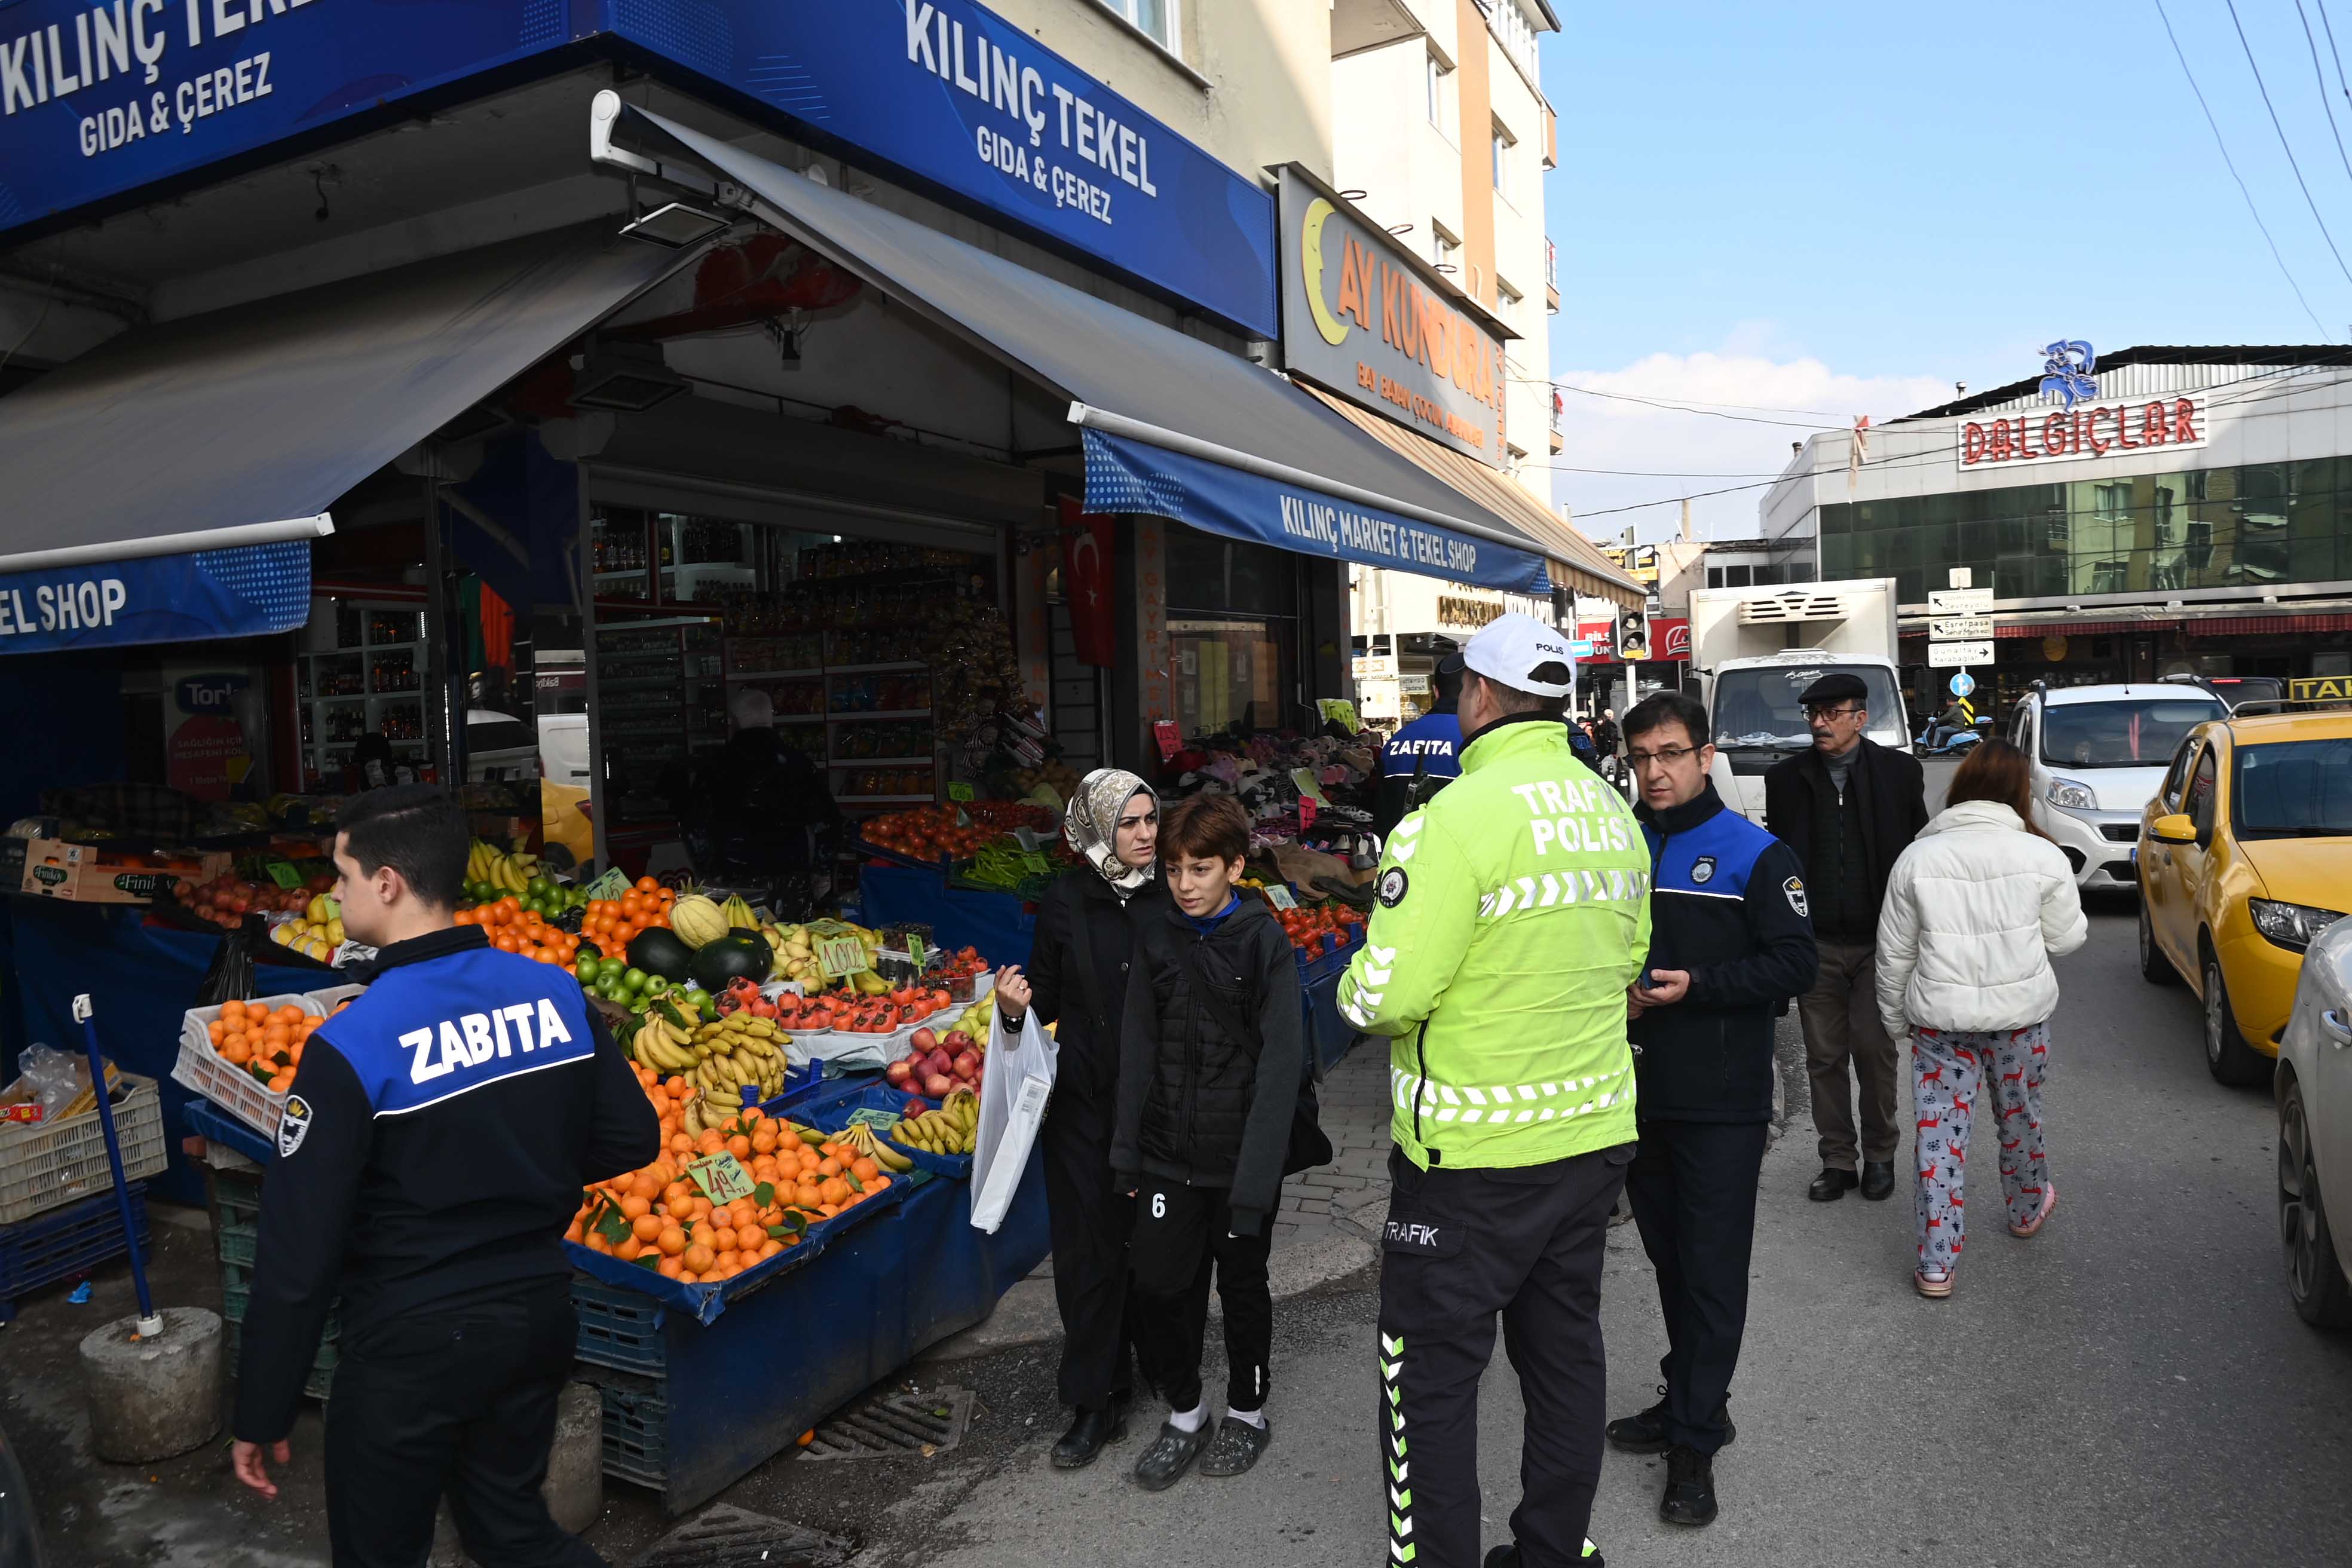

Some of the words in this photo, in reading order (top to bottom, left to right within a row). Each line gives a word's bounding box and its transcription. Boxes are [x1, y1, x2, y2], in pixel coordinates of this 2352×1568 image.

[0, 0, 166, 115] KILINÇ
[79, 100, 145, 157] GIDA
[149, 91, 170, 133] &
[176, 51, 272, 133] ÇEREZ
[906, 0, 1046, 146] KILINÇ
[1052, 82, 1157, 198] TEKEL
[976, 125, 1030, 182] GIDA
[1033, 156, 1048, 193] &
[1052, 166, 1112, 225] ÇEREZ
[1338, 231, 1374, 331] AY
[1380, 261, 1494, 409] KUNDURA
[1964, 398, 2198, 465] DALGIÇLAR
[1280, 495, 1337, 553] KILINÇ
[1339, 510, 1396, 556] MARKET
[1399, 526, 1410, 559] &
[1409, 529, 1447, 567] TEKEL
[1448, 539, 1475, 573] SHOP
[36, 579, 125, 631] SHOP
[1511, 780, 1625, 816] TRAFİK
[1530, 817, 1635, 856] POLİSİ
[398, 998, 572, 1085] ZABITA
[706, 1167, 736, 1199] 49
[1152, 1193, 1166, 1218] 6
[1383, 1220, 1440, 1247] TRAFİK
